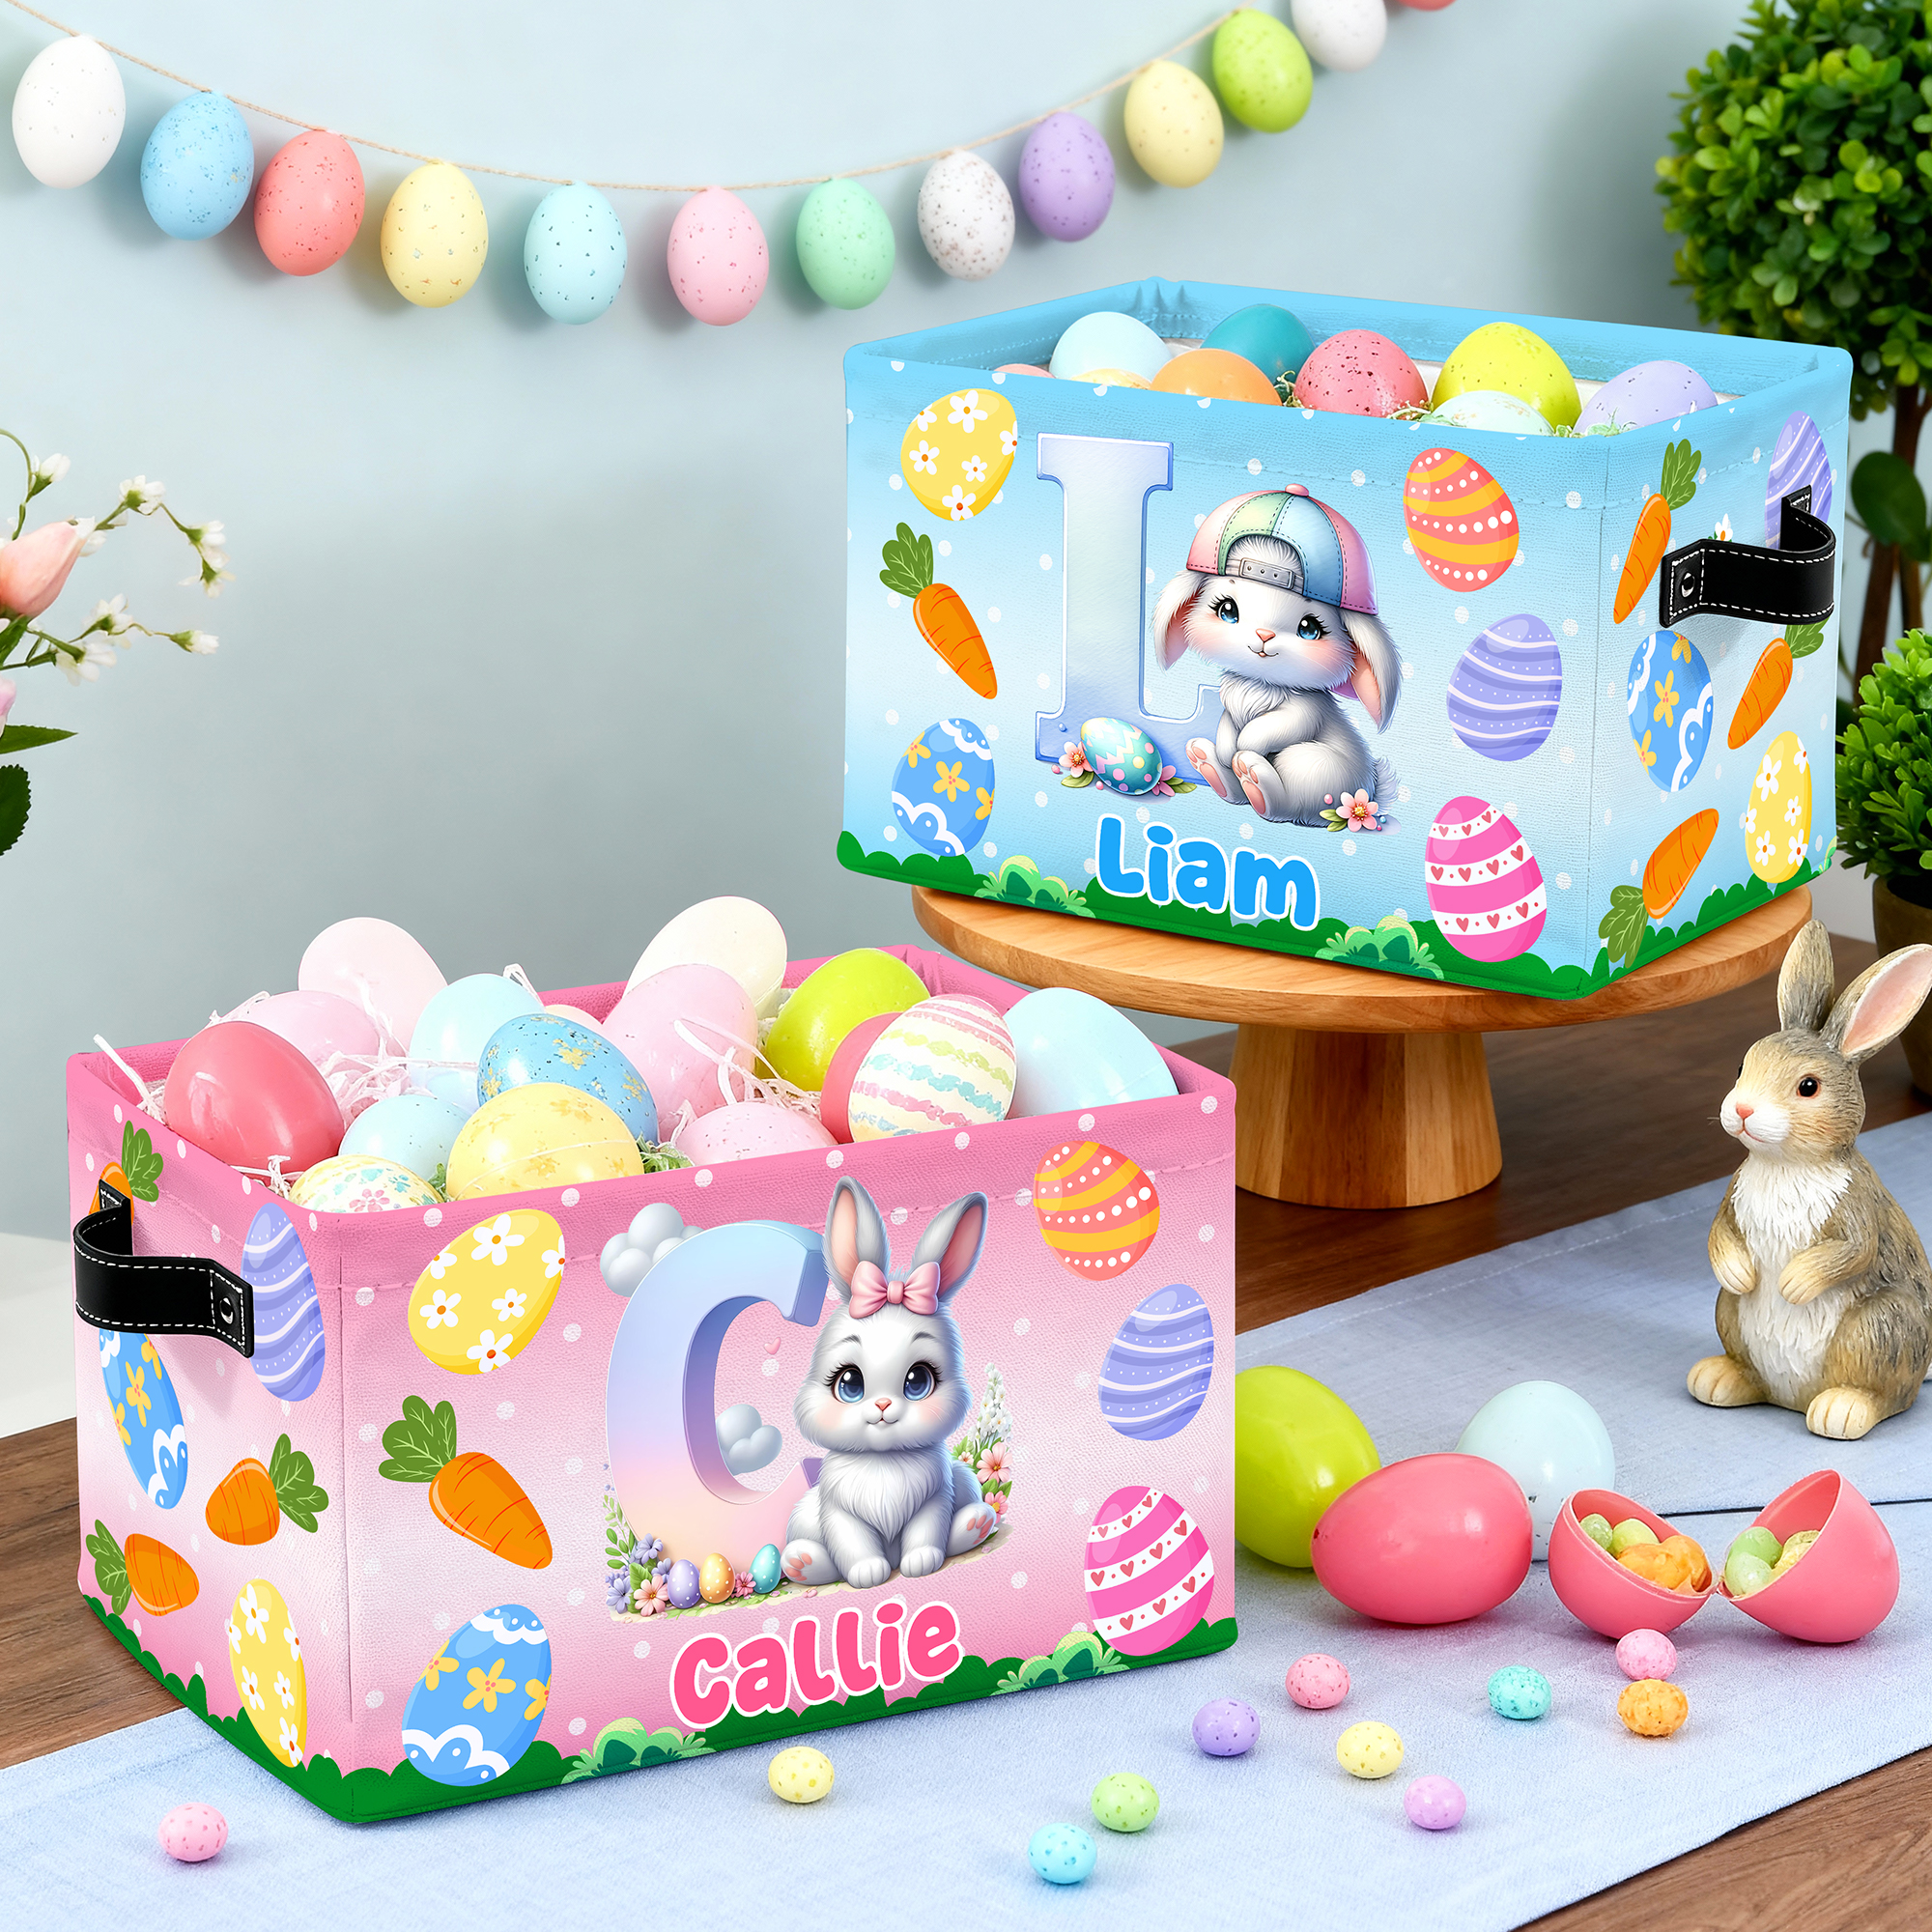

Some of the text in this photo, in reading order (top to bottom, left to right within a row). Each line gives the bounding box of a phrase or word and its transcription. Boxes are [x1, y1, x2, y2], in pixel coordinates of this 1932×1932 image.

[1035, 432, 1223, 786] L
[1095, 815, 1320, 930] Liam
[607, 1219, 829, 1575] C
[671, 1600, 961, 1727] Callie
